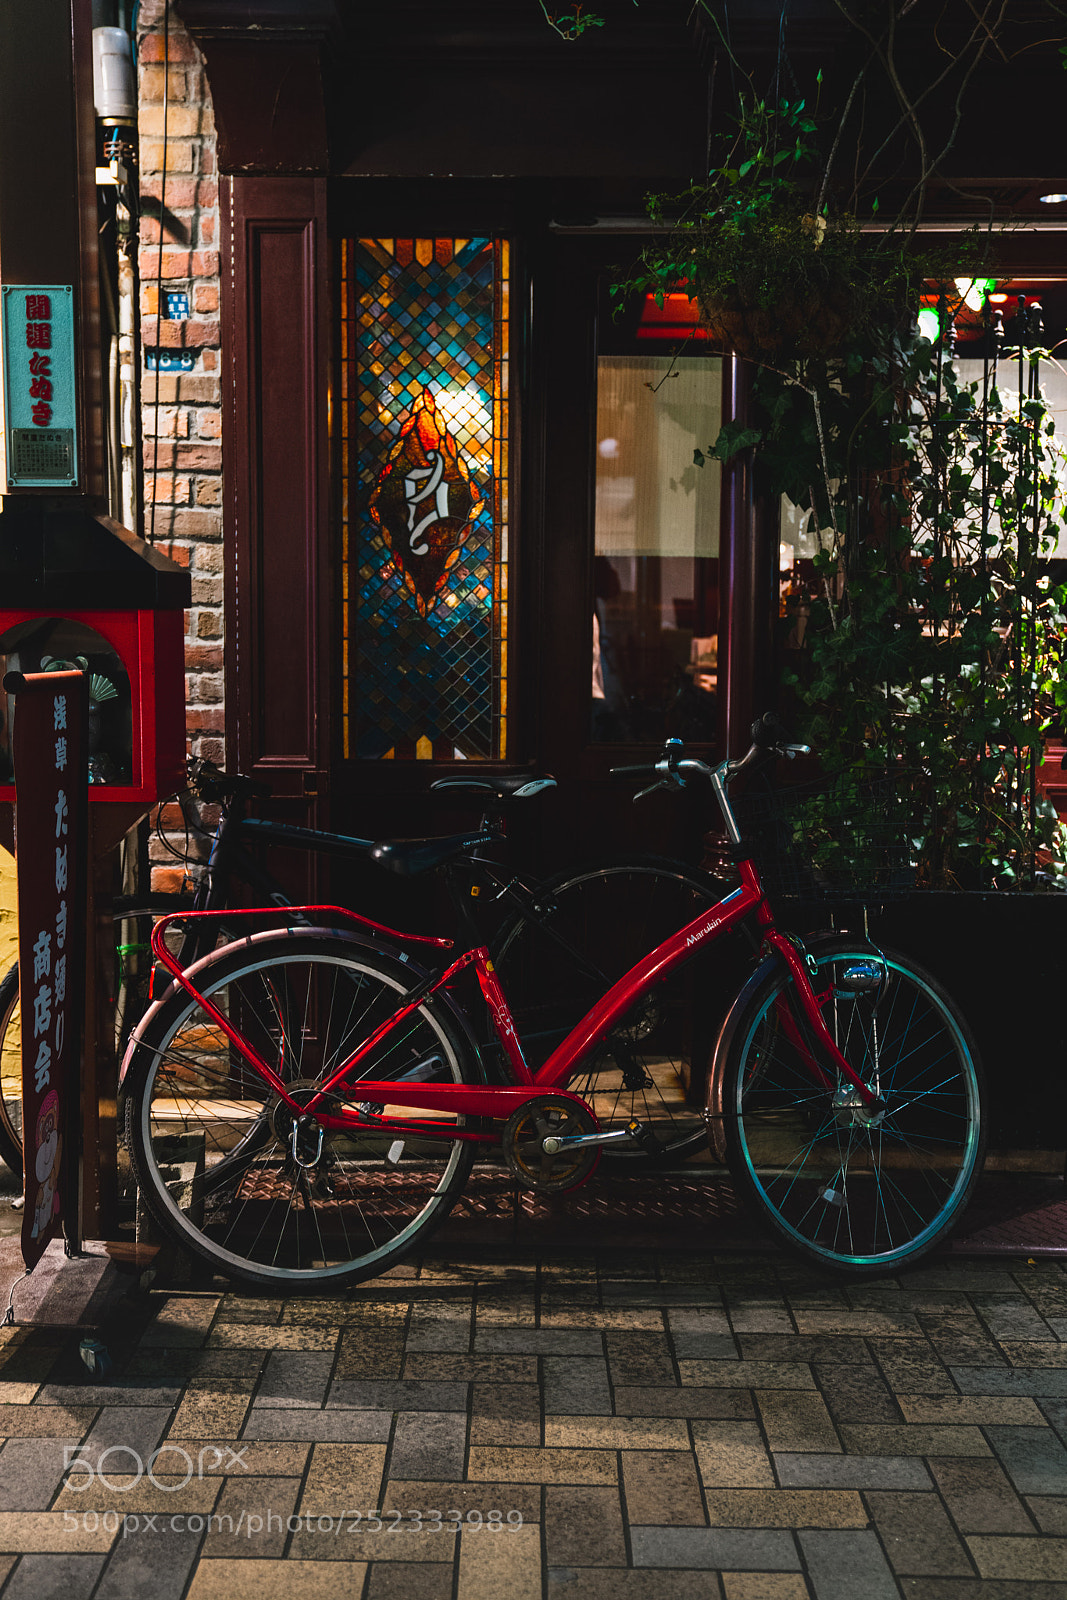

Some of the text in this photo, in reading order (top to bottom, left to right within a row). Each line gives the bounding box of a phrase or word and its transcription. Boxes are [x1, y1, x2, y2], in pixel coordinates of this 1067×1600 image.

[25, 294, 51, 426] 開運たぬき
[53, 695, 68, 1060] 浅草 たぬき通り
[686, 917, 722, 947] Marukin
[33, 930, 52, 1093] 商店会
